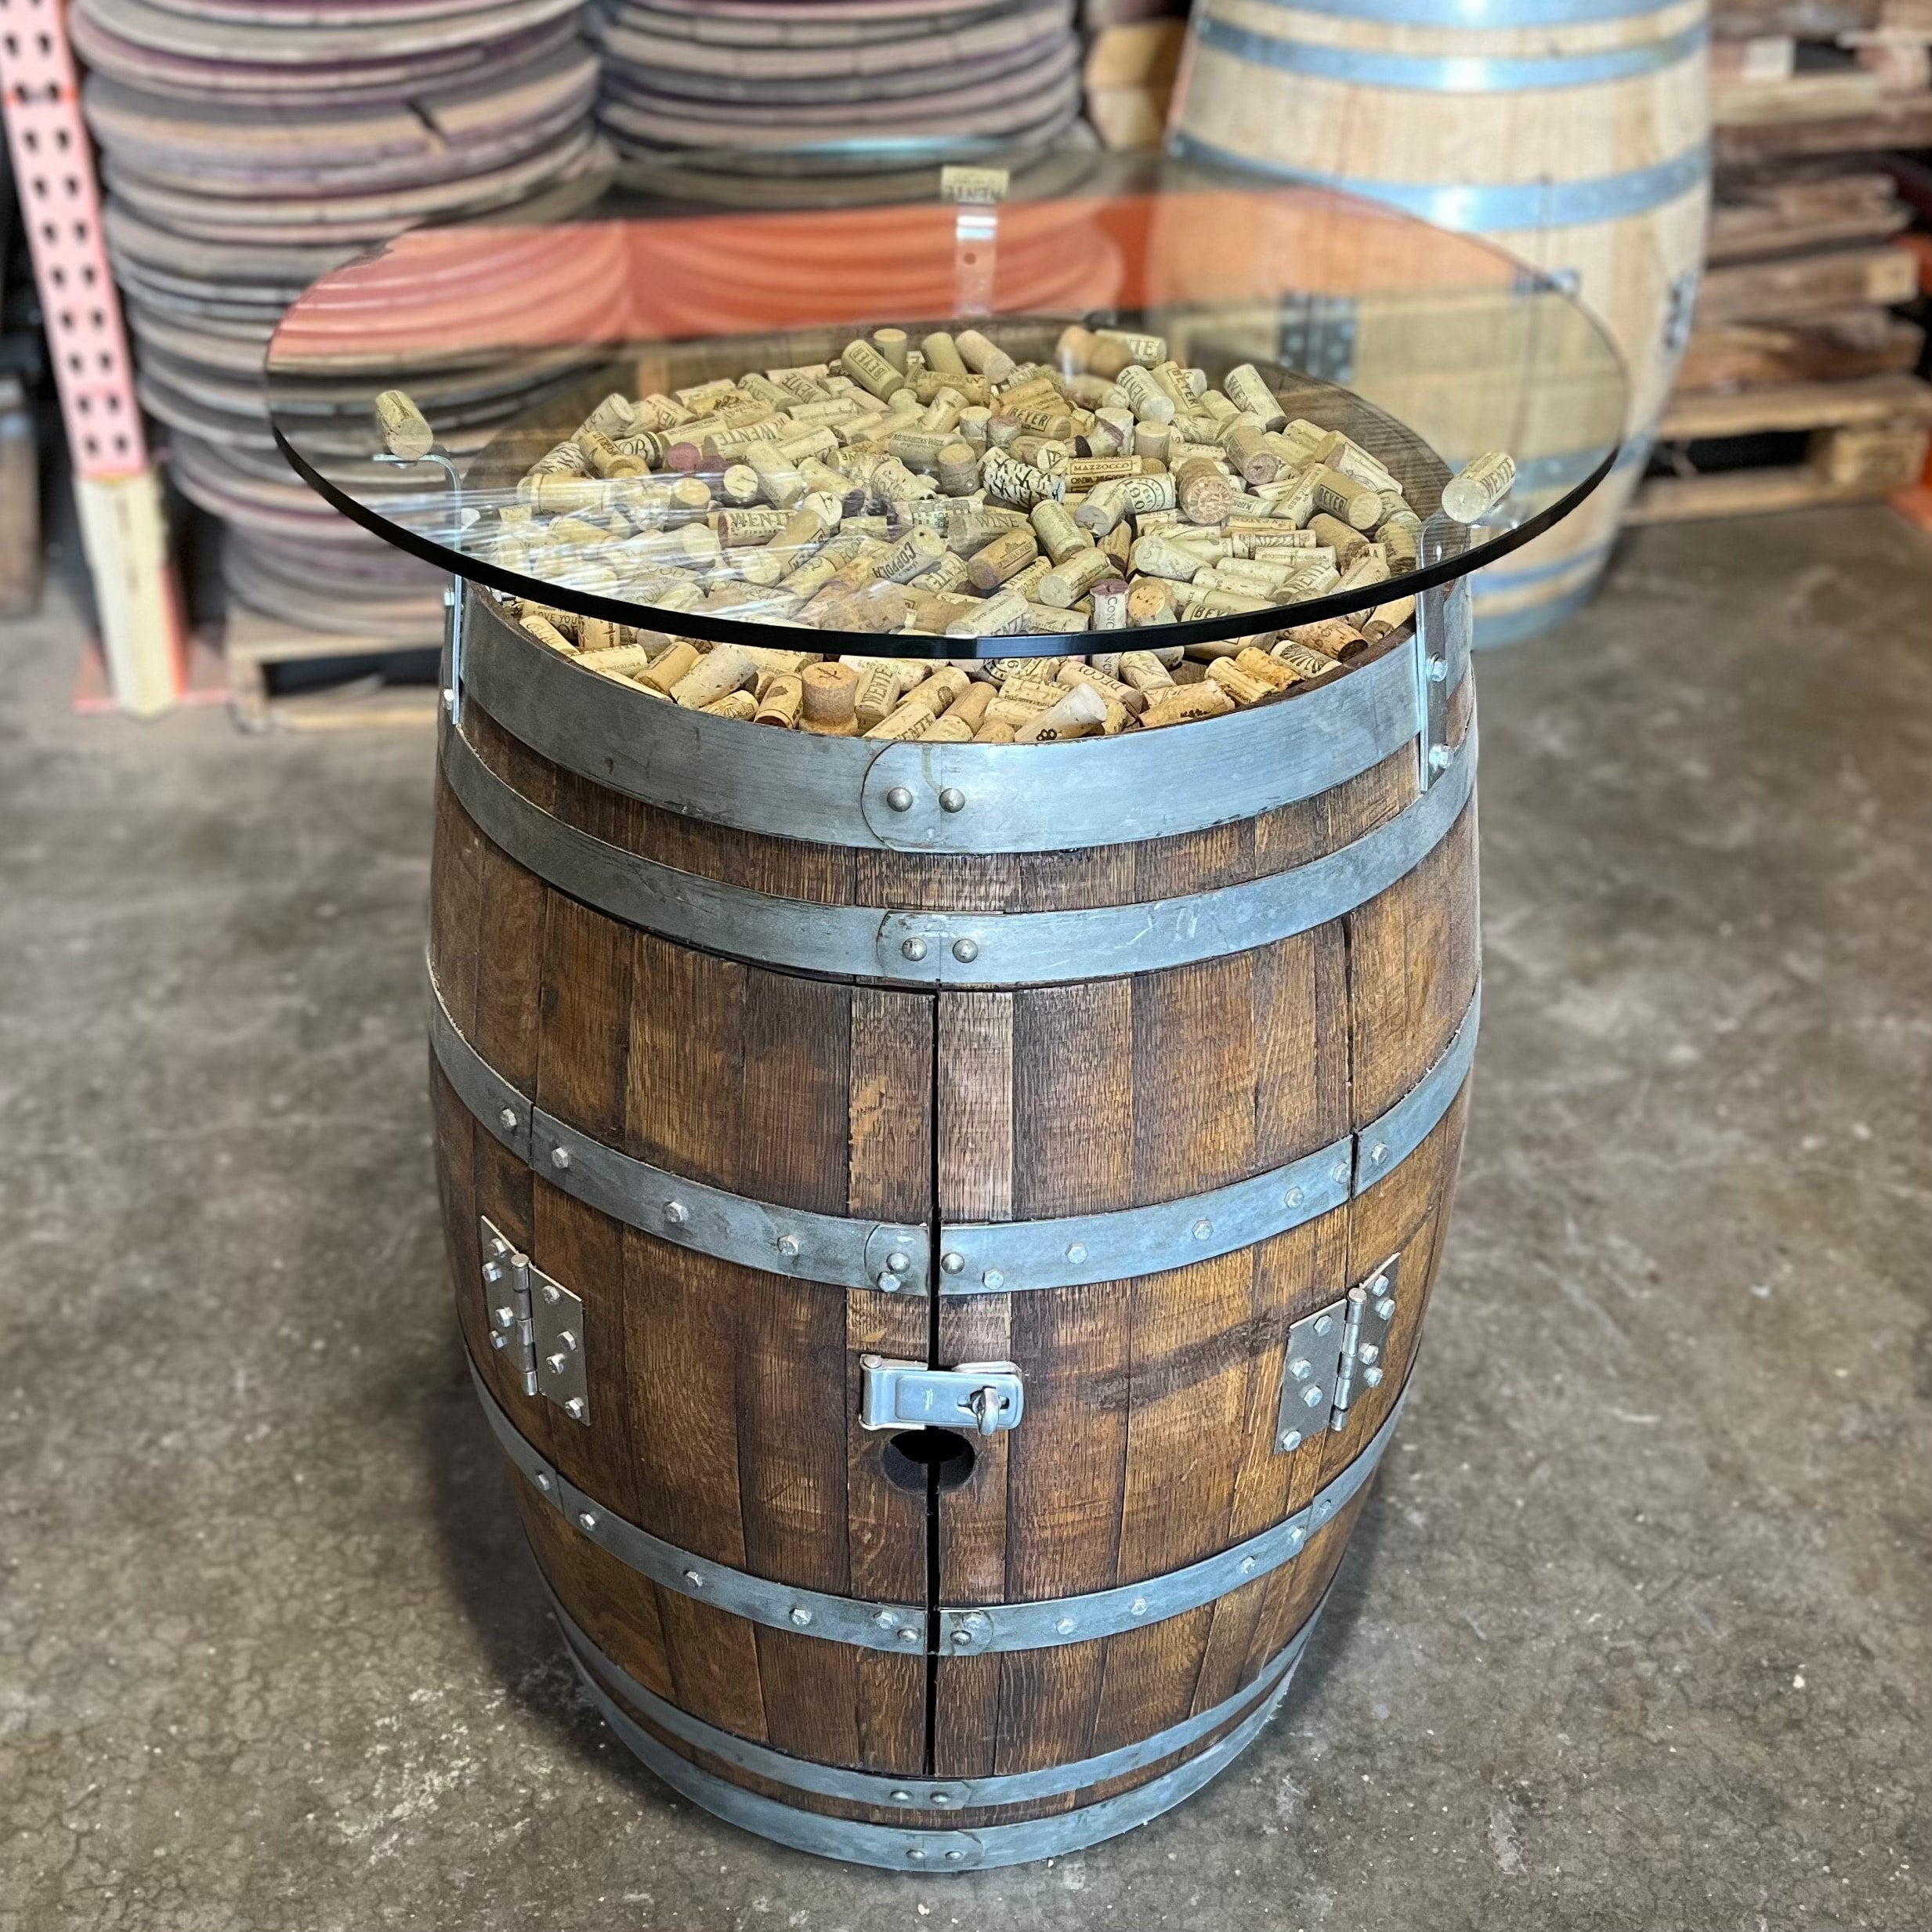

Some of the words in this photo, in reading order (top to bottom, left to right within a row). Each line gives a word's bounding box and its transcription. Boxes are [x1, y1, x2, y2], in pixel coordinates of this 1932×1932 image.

[852, 348, 887, 379] BEYER
[782, 372, 819, 403] WENTE
[1172, 369, 1199, 406] BEYER
[1228, 374, 1261, 415] WENT
[714, 419, 777, 446] WENTE
[1010, 407, 1048, 427] BEYER
[1073, 462, 1130, 472] MAZZOCCO
[1478, 457, 1515, 500] WENTE
[1319, 487, 1344, 511] BEYER
[976, 514, 1018, 528] WINE
[873, 541, 916, 581] COPPOLA
[863, 668, 893, 704] WENTE
[1078, 666, 1123, 691] DECOY
